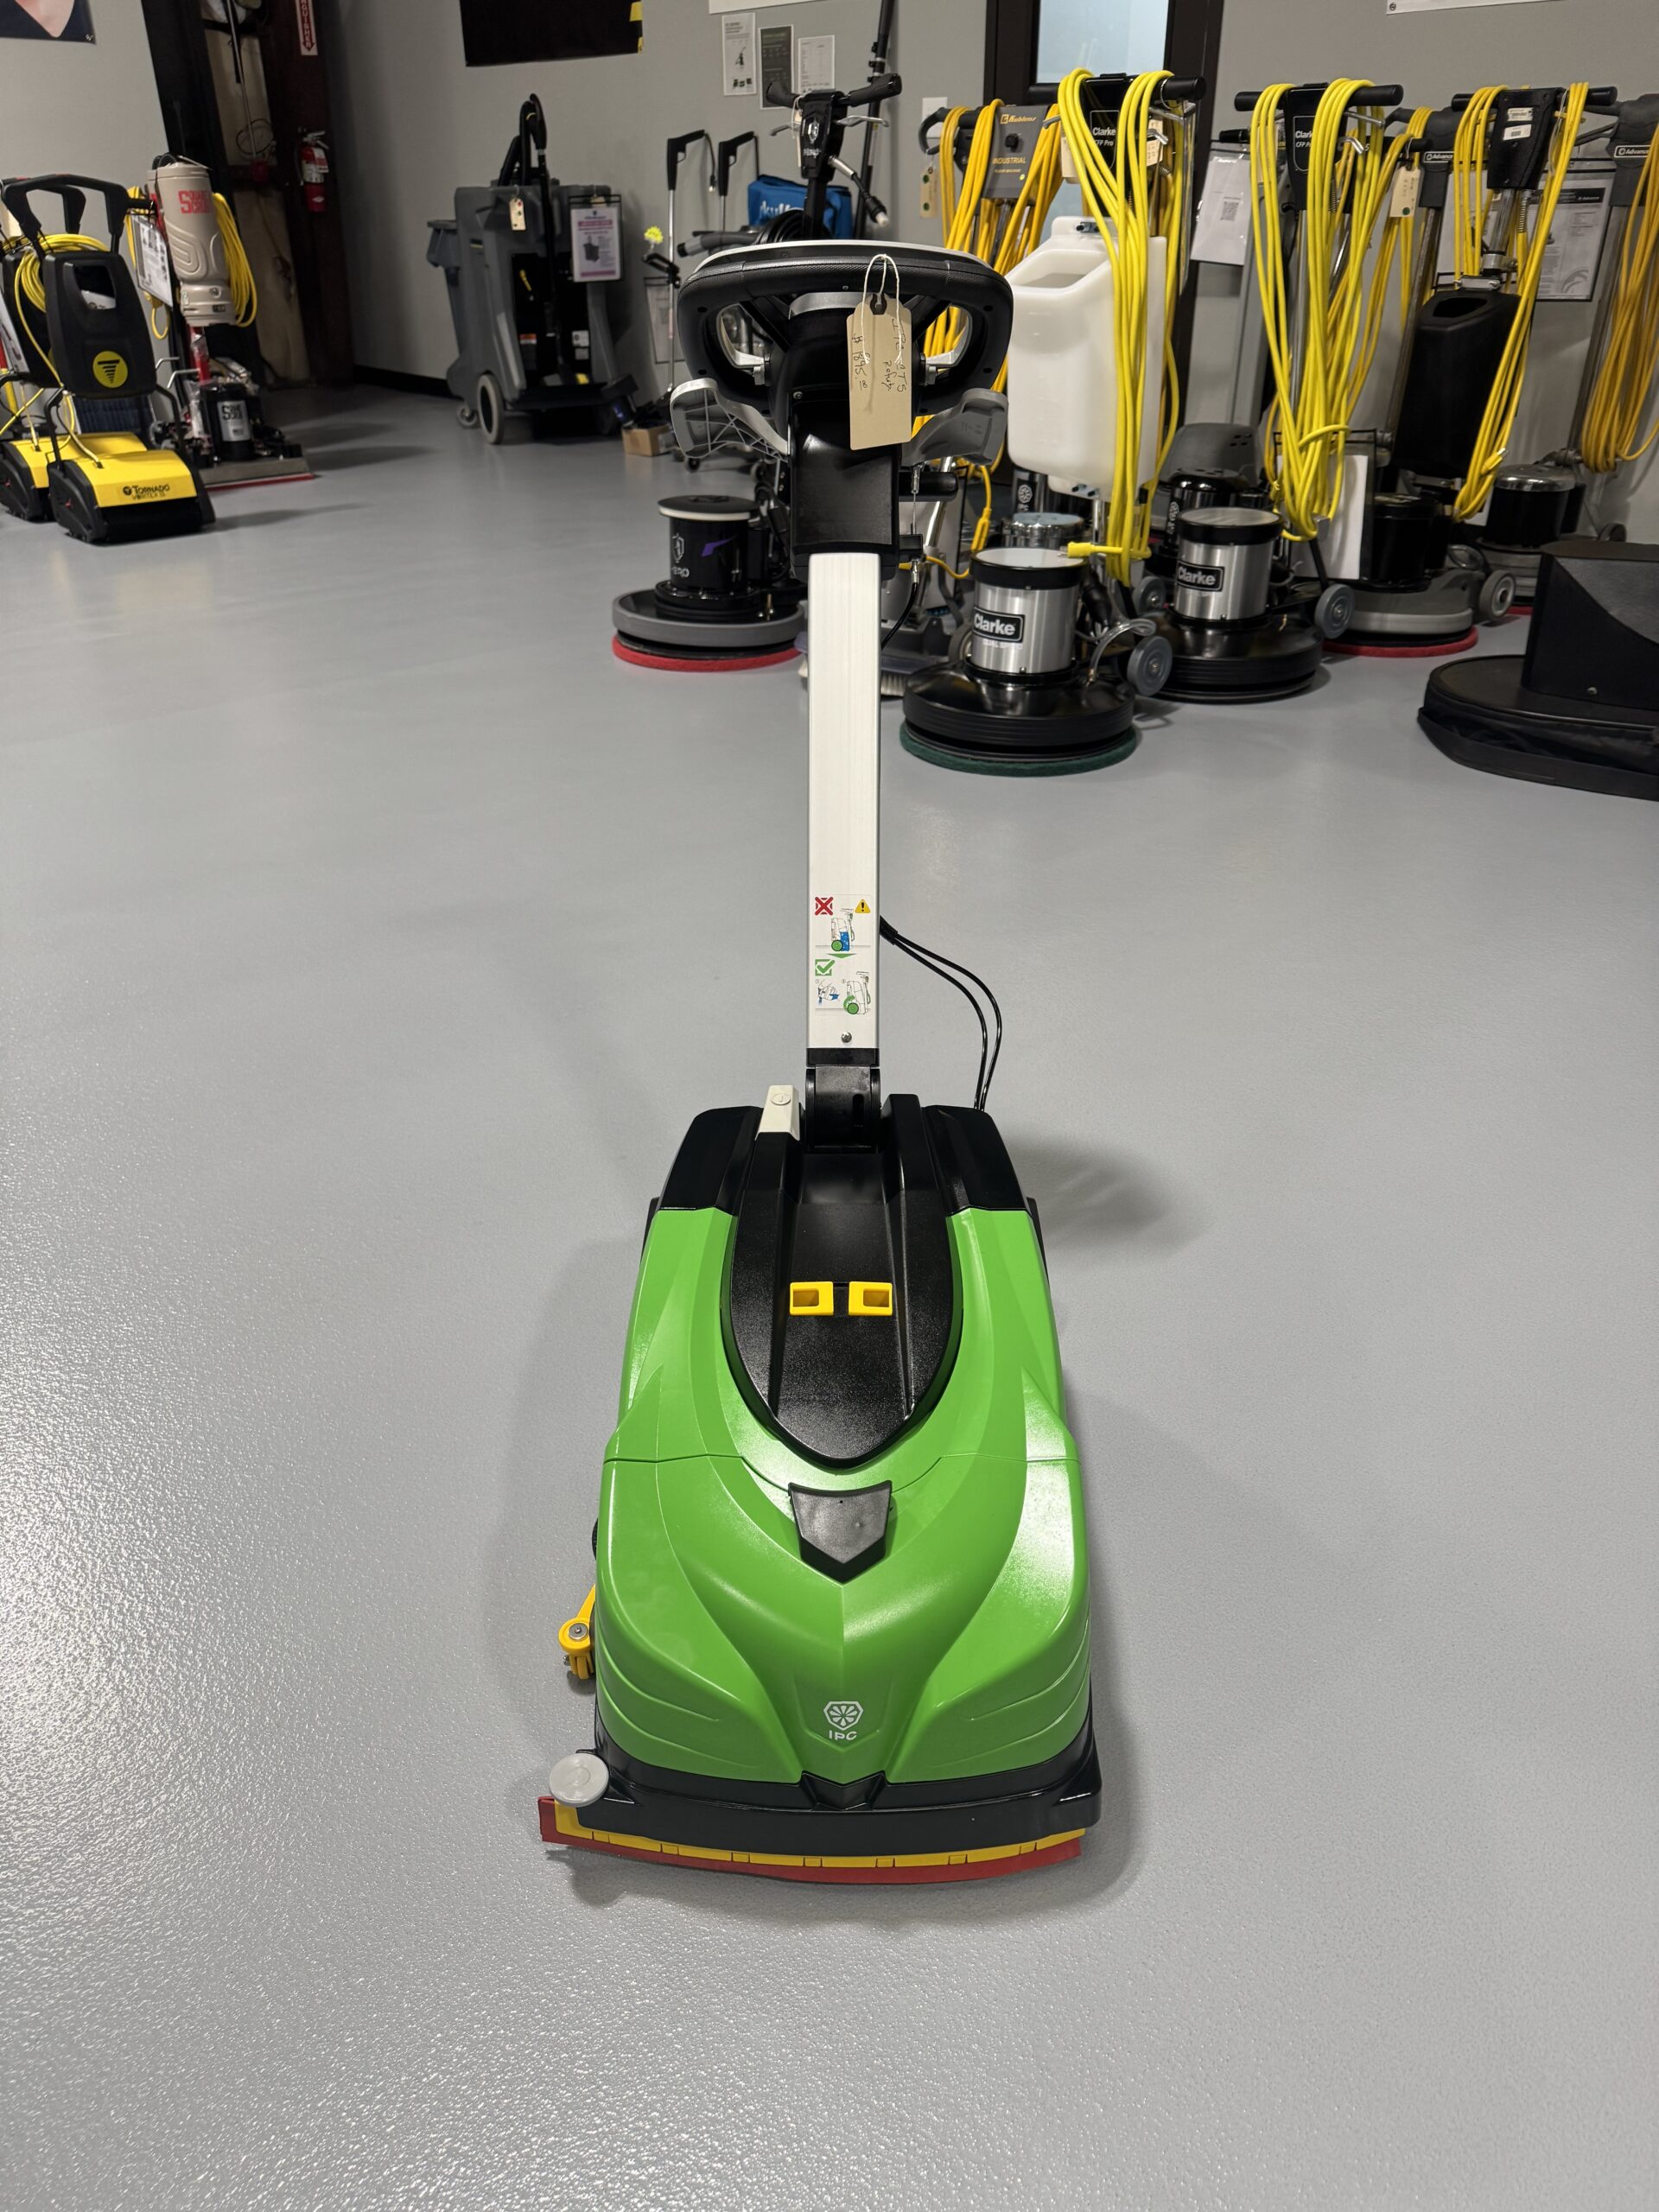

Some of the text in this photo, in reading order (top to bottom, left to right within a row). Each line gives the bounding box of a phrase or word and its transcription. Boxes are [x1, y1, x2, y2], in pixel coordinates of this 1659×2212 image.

[1092, 127, 1116, 136] Clarke
[1178, 566, 1217, 586] Clarke
[974, 613, 1016, 636] Clarke
[829, 1729, 858, 1741] IPC
